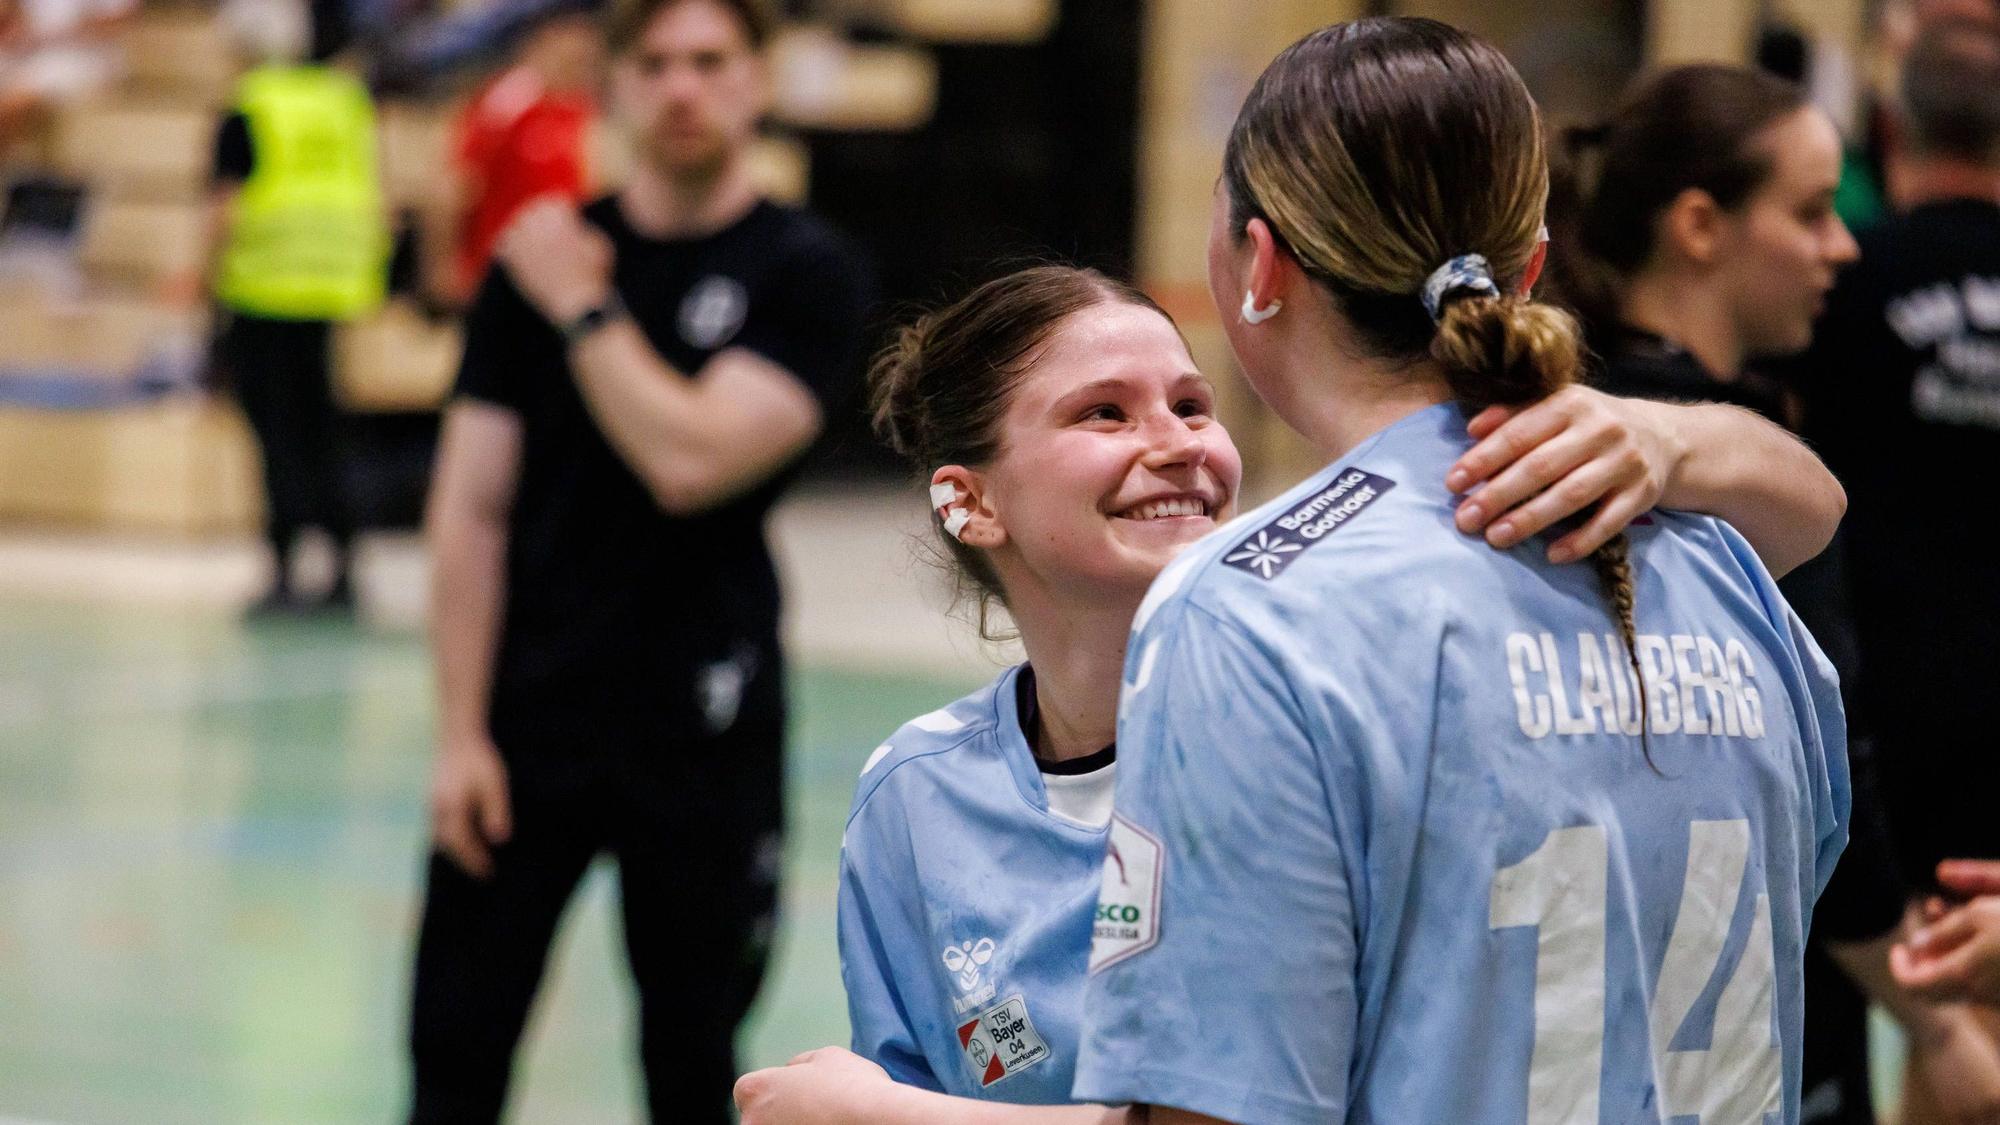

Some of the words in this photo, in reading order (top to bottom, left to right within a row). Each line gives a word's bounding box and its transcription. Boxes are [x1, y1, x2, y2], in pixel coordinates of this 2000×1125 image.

[1276, 472, 1367, 530] Barmenia
[1300, 483, 1377, 539] Gothaer
[1505, 632, 1765, 739] CLAUBERG
[1489, 818, 1783, 1125] 14
[991, 1007, 1012, 1026] TSV
[991, 1017, 1026, 1044] Bayer
[1005, 1045, 1043, 1069] Leverkusen
[1009, 1038, 1025, 1055] 04
